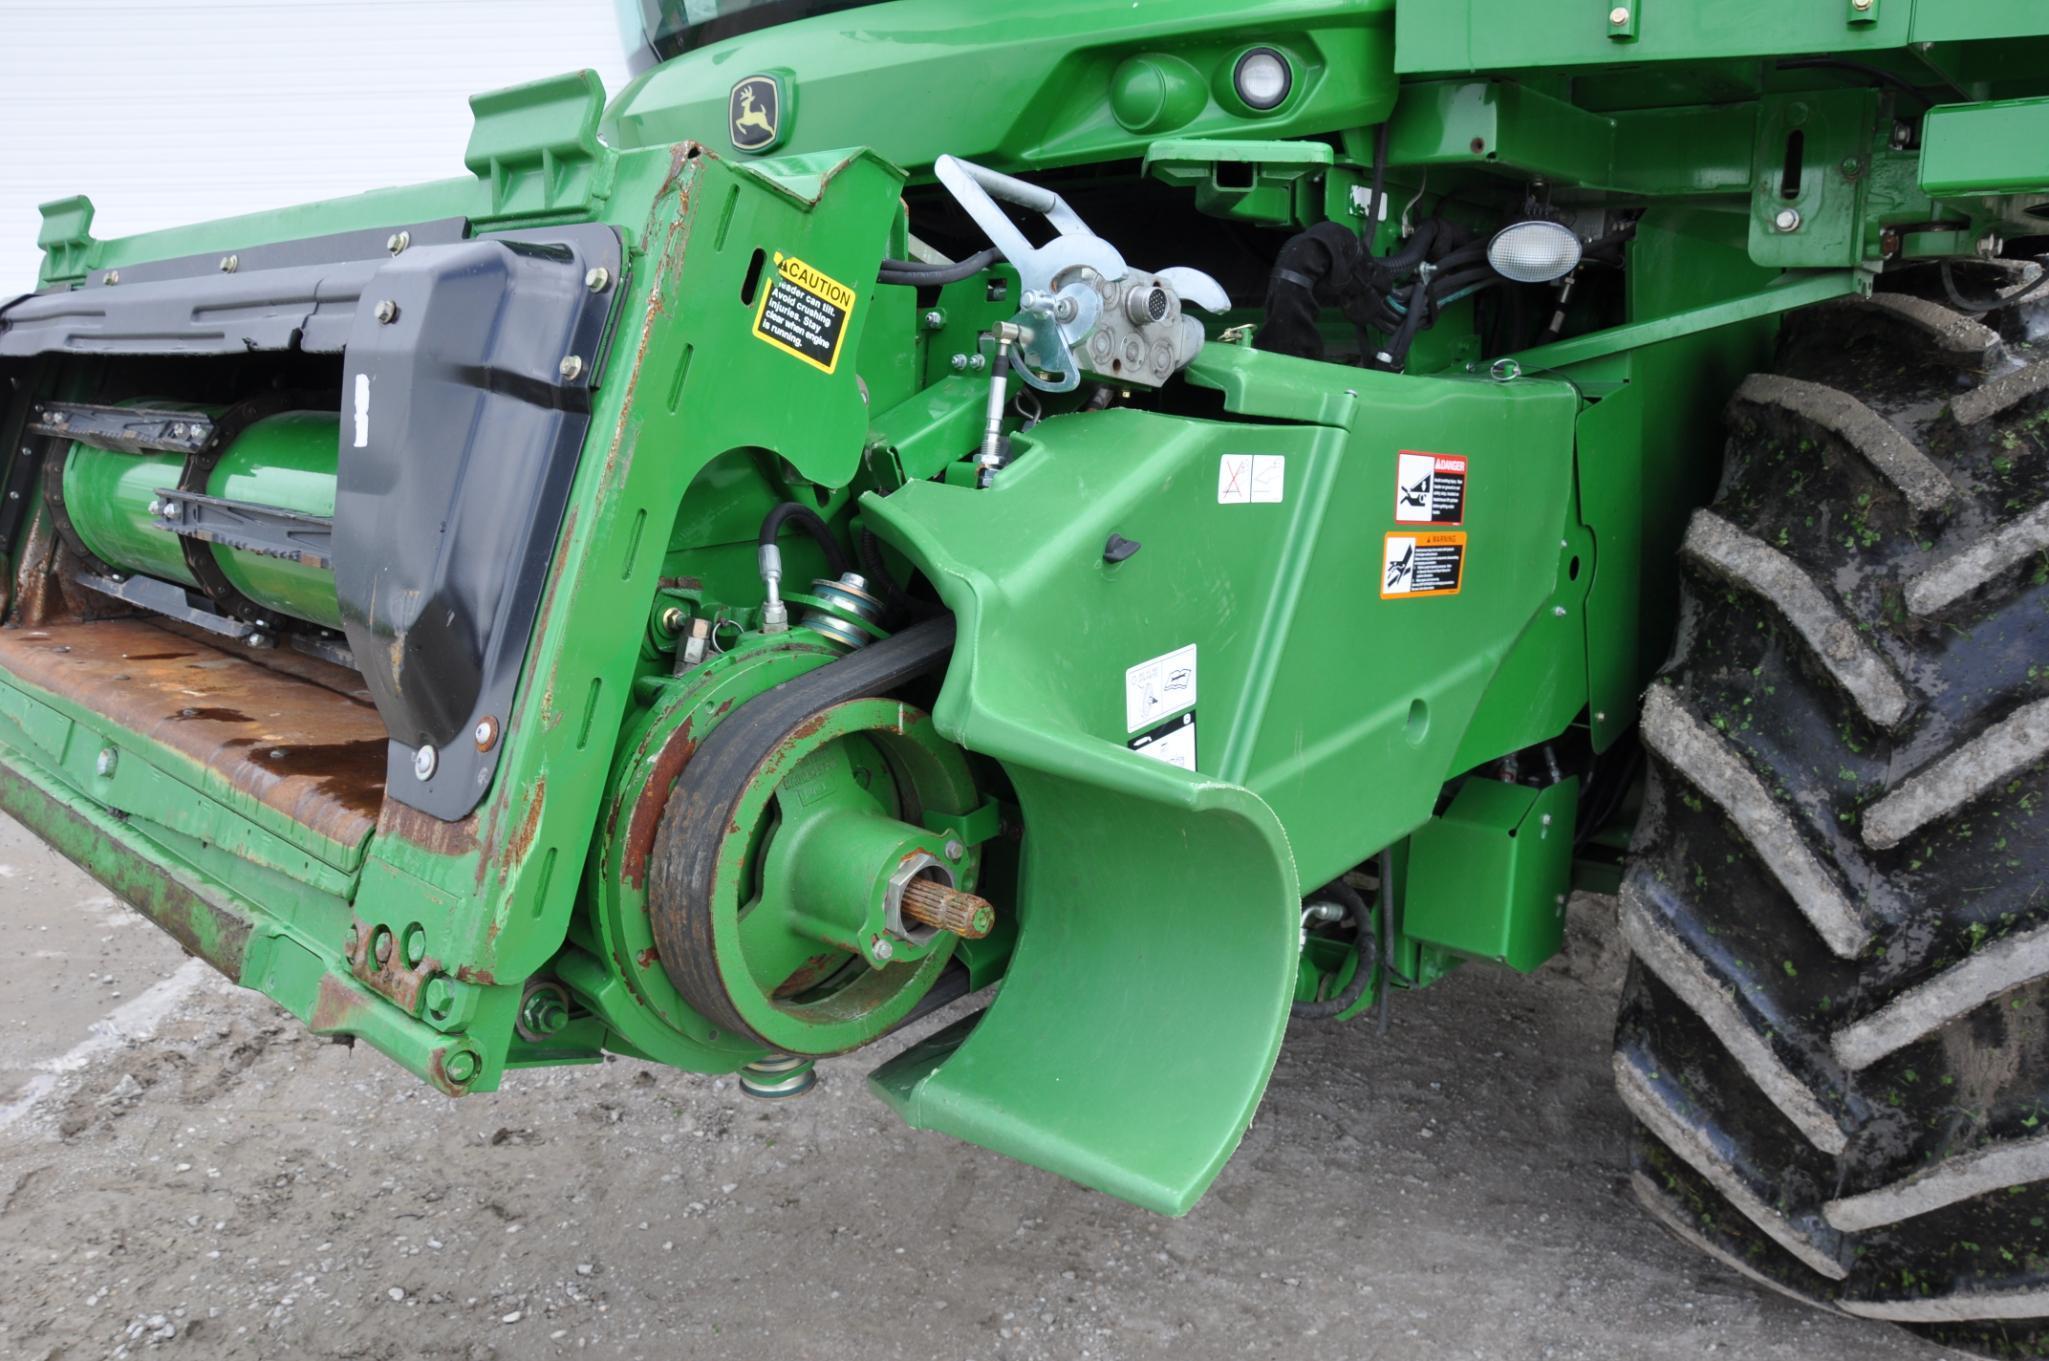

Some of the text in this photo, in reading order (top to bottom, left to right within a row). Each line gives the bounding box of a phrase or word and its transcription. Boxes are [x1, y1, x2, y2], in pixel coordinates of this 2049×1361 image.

[789, 263, 851, 307] CAUTION
[769, 298, 821, 334] injuries. Stay
[772, 288, 831, 327] Avoid crushing
[806, 296, 821, 308] can
[822, 303, 835, 317] tilt.
[762, 318, 802, 347] is running.
[765, 310, 830, 349] clear when engine
